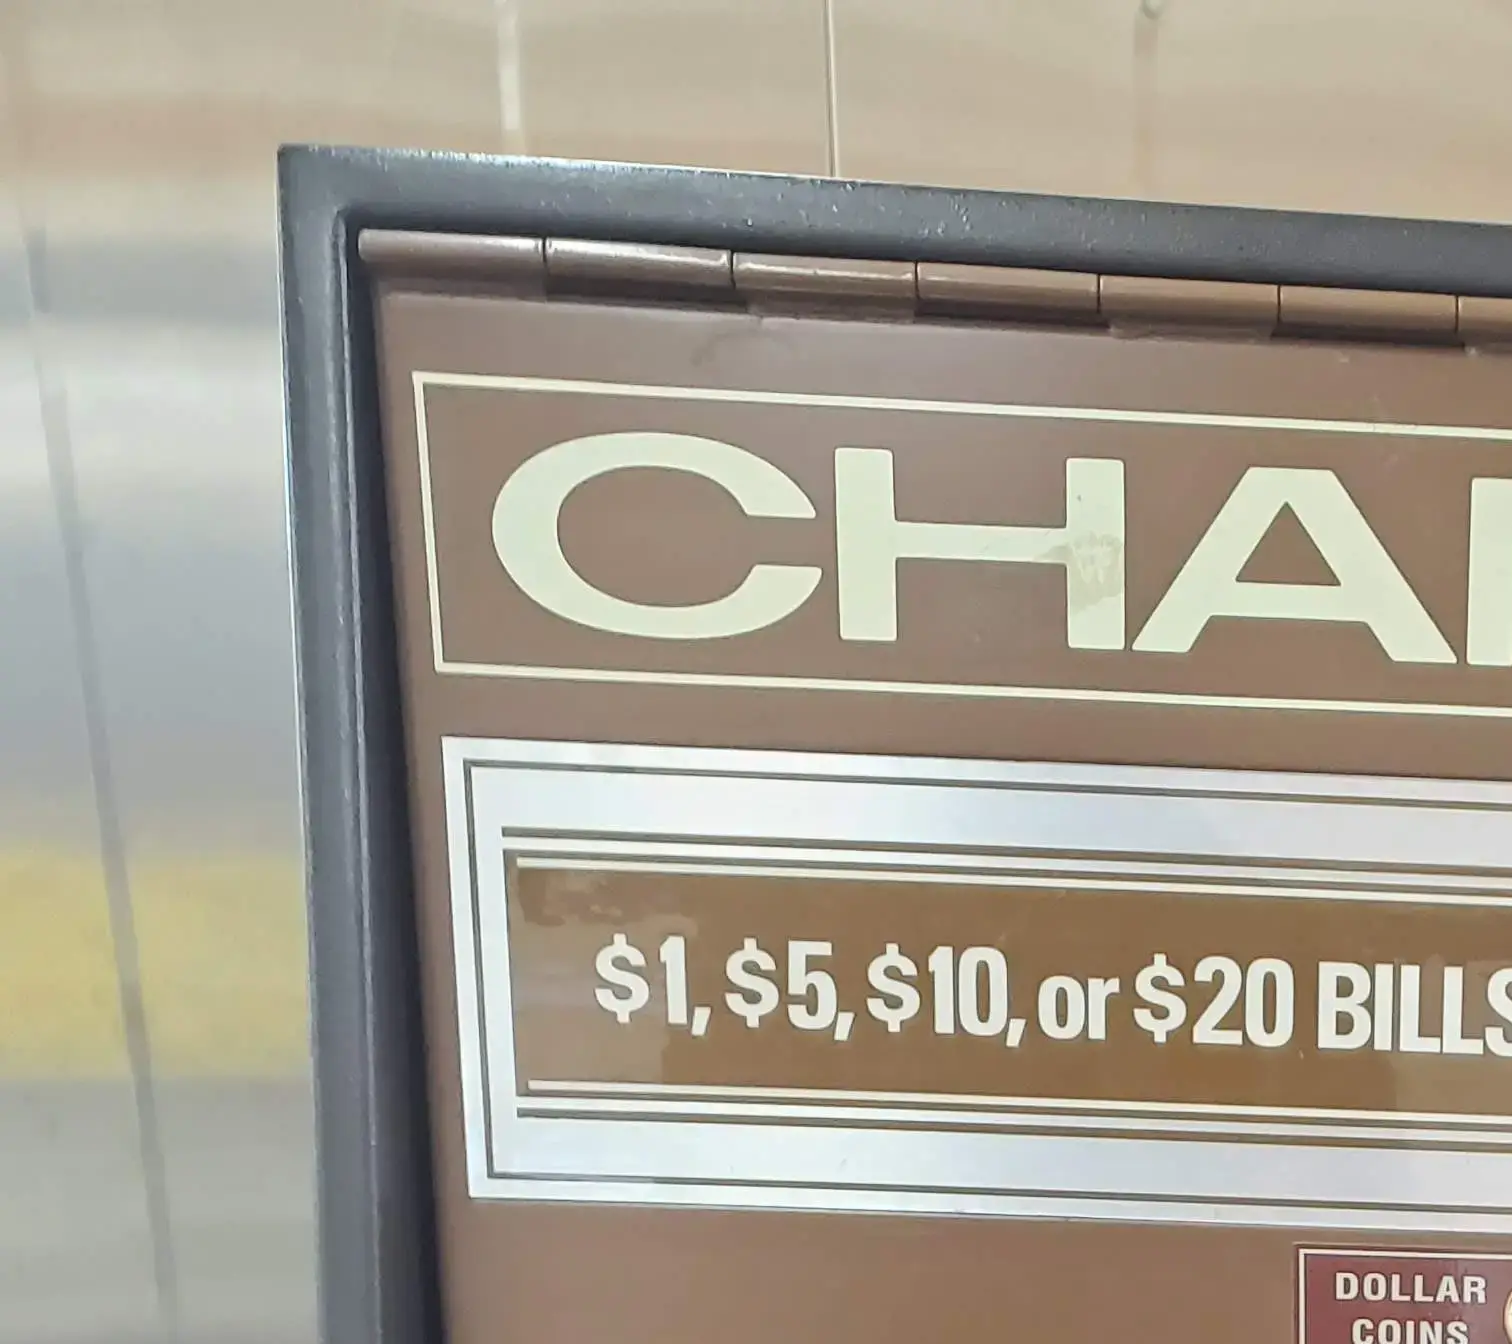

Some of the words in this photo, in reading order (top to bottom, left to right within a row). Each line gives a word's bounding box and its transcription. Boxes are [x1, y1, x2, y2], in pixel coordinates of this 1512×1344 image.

[594, 932, 713, 1036] $1,
[724, 936, 856, 1042] $5,
[865, 944, 1026, 1050] $10,
[1036, 975, 1118, 1042] or
[1132, 954, 1295, 1048] $20
[1335, 1272, 1487, 1304] DOLLAR
